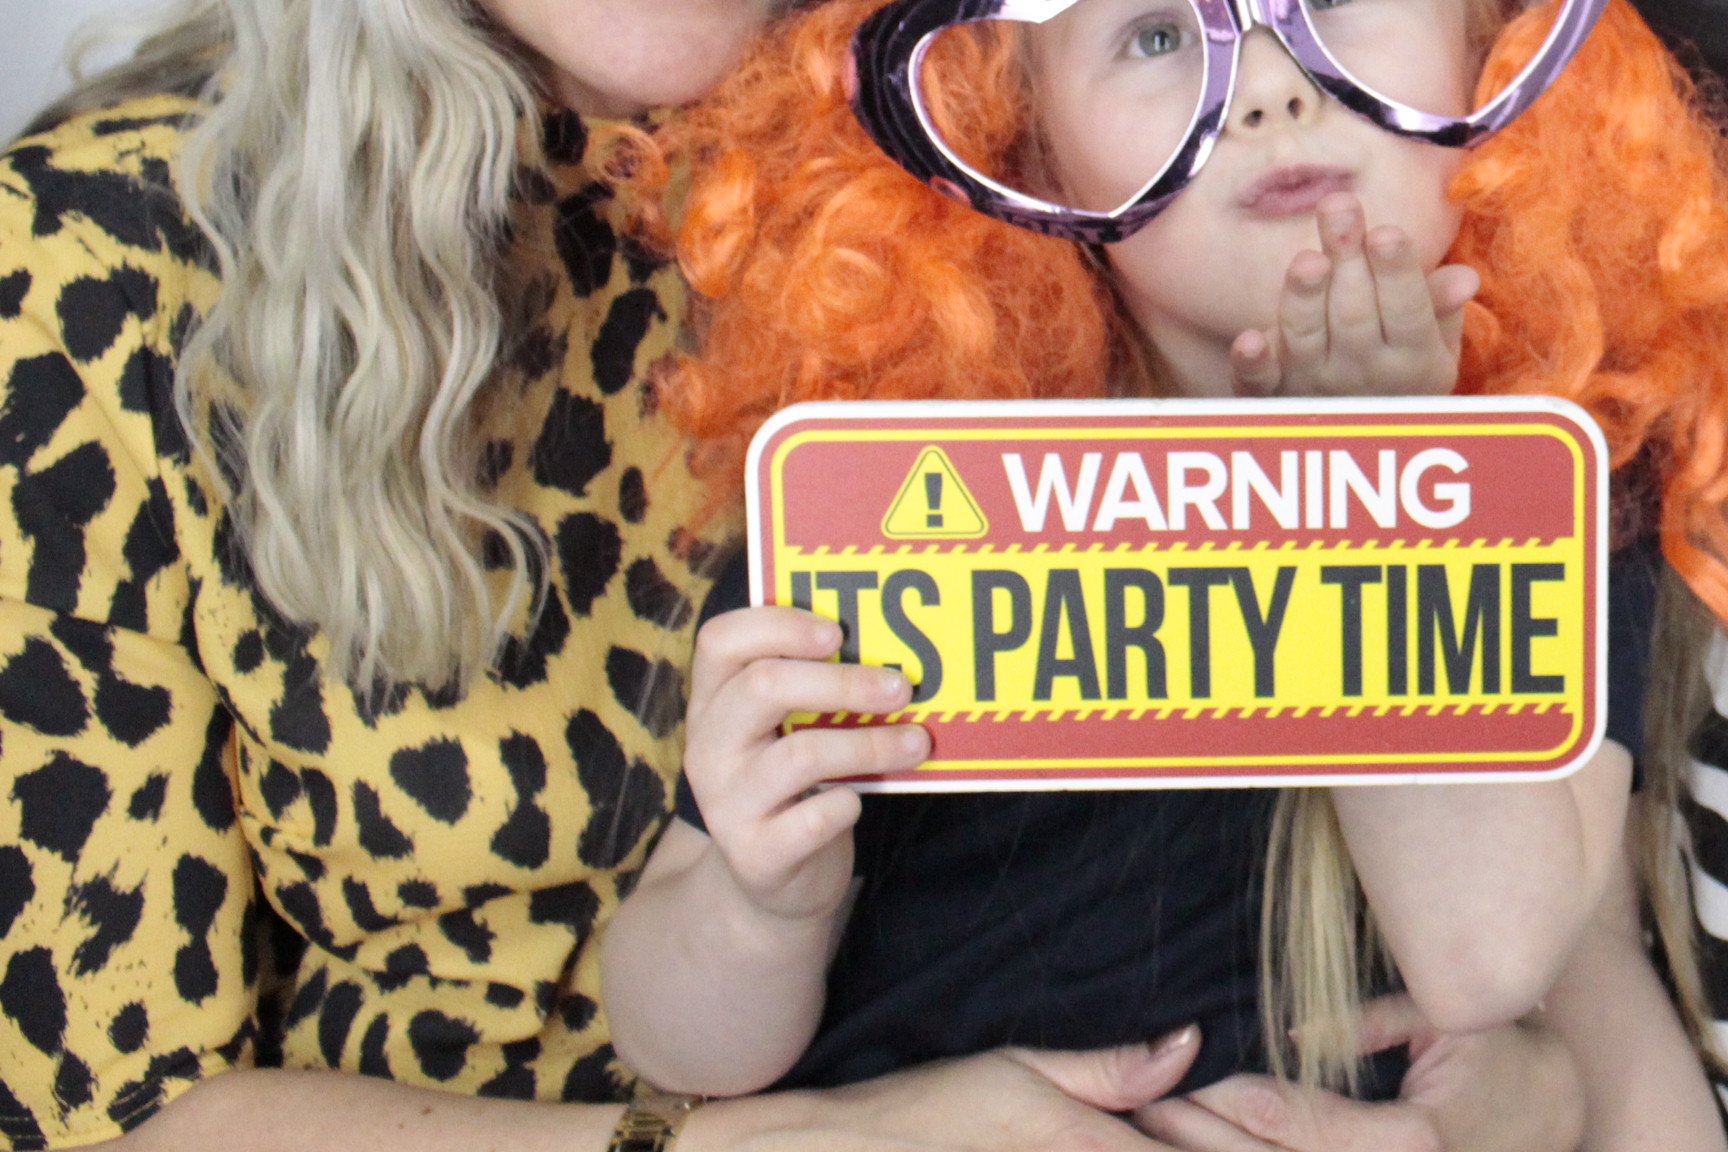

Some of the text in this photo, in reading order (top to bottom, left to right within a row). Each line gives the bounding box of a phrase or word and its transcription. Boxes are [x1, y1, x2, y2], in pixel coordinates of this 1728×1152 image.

[1002, 448, 1471, 532] WARNING
[791, 562, 1566, 703] TS PARTY TIME
